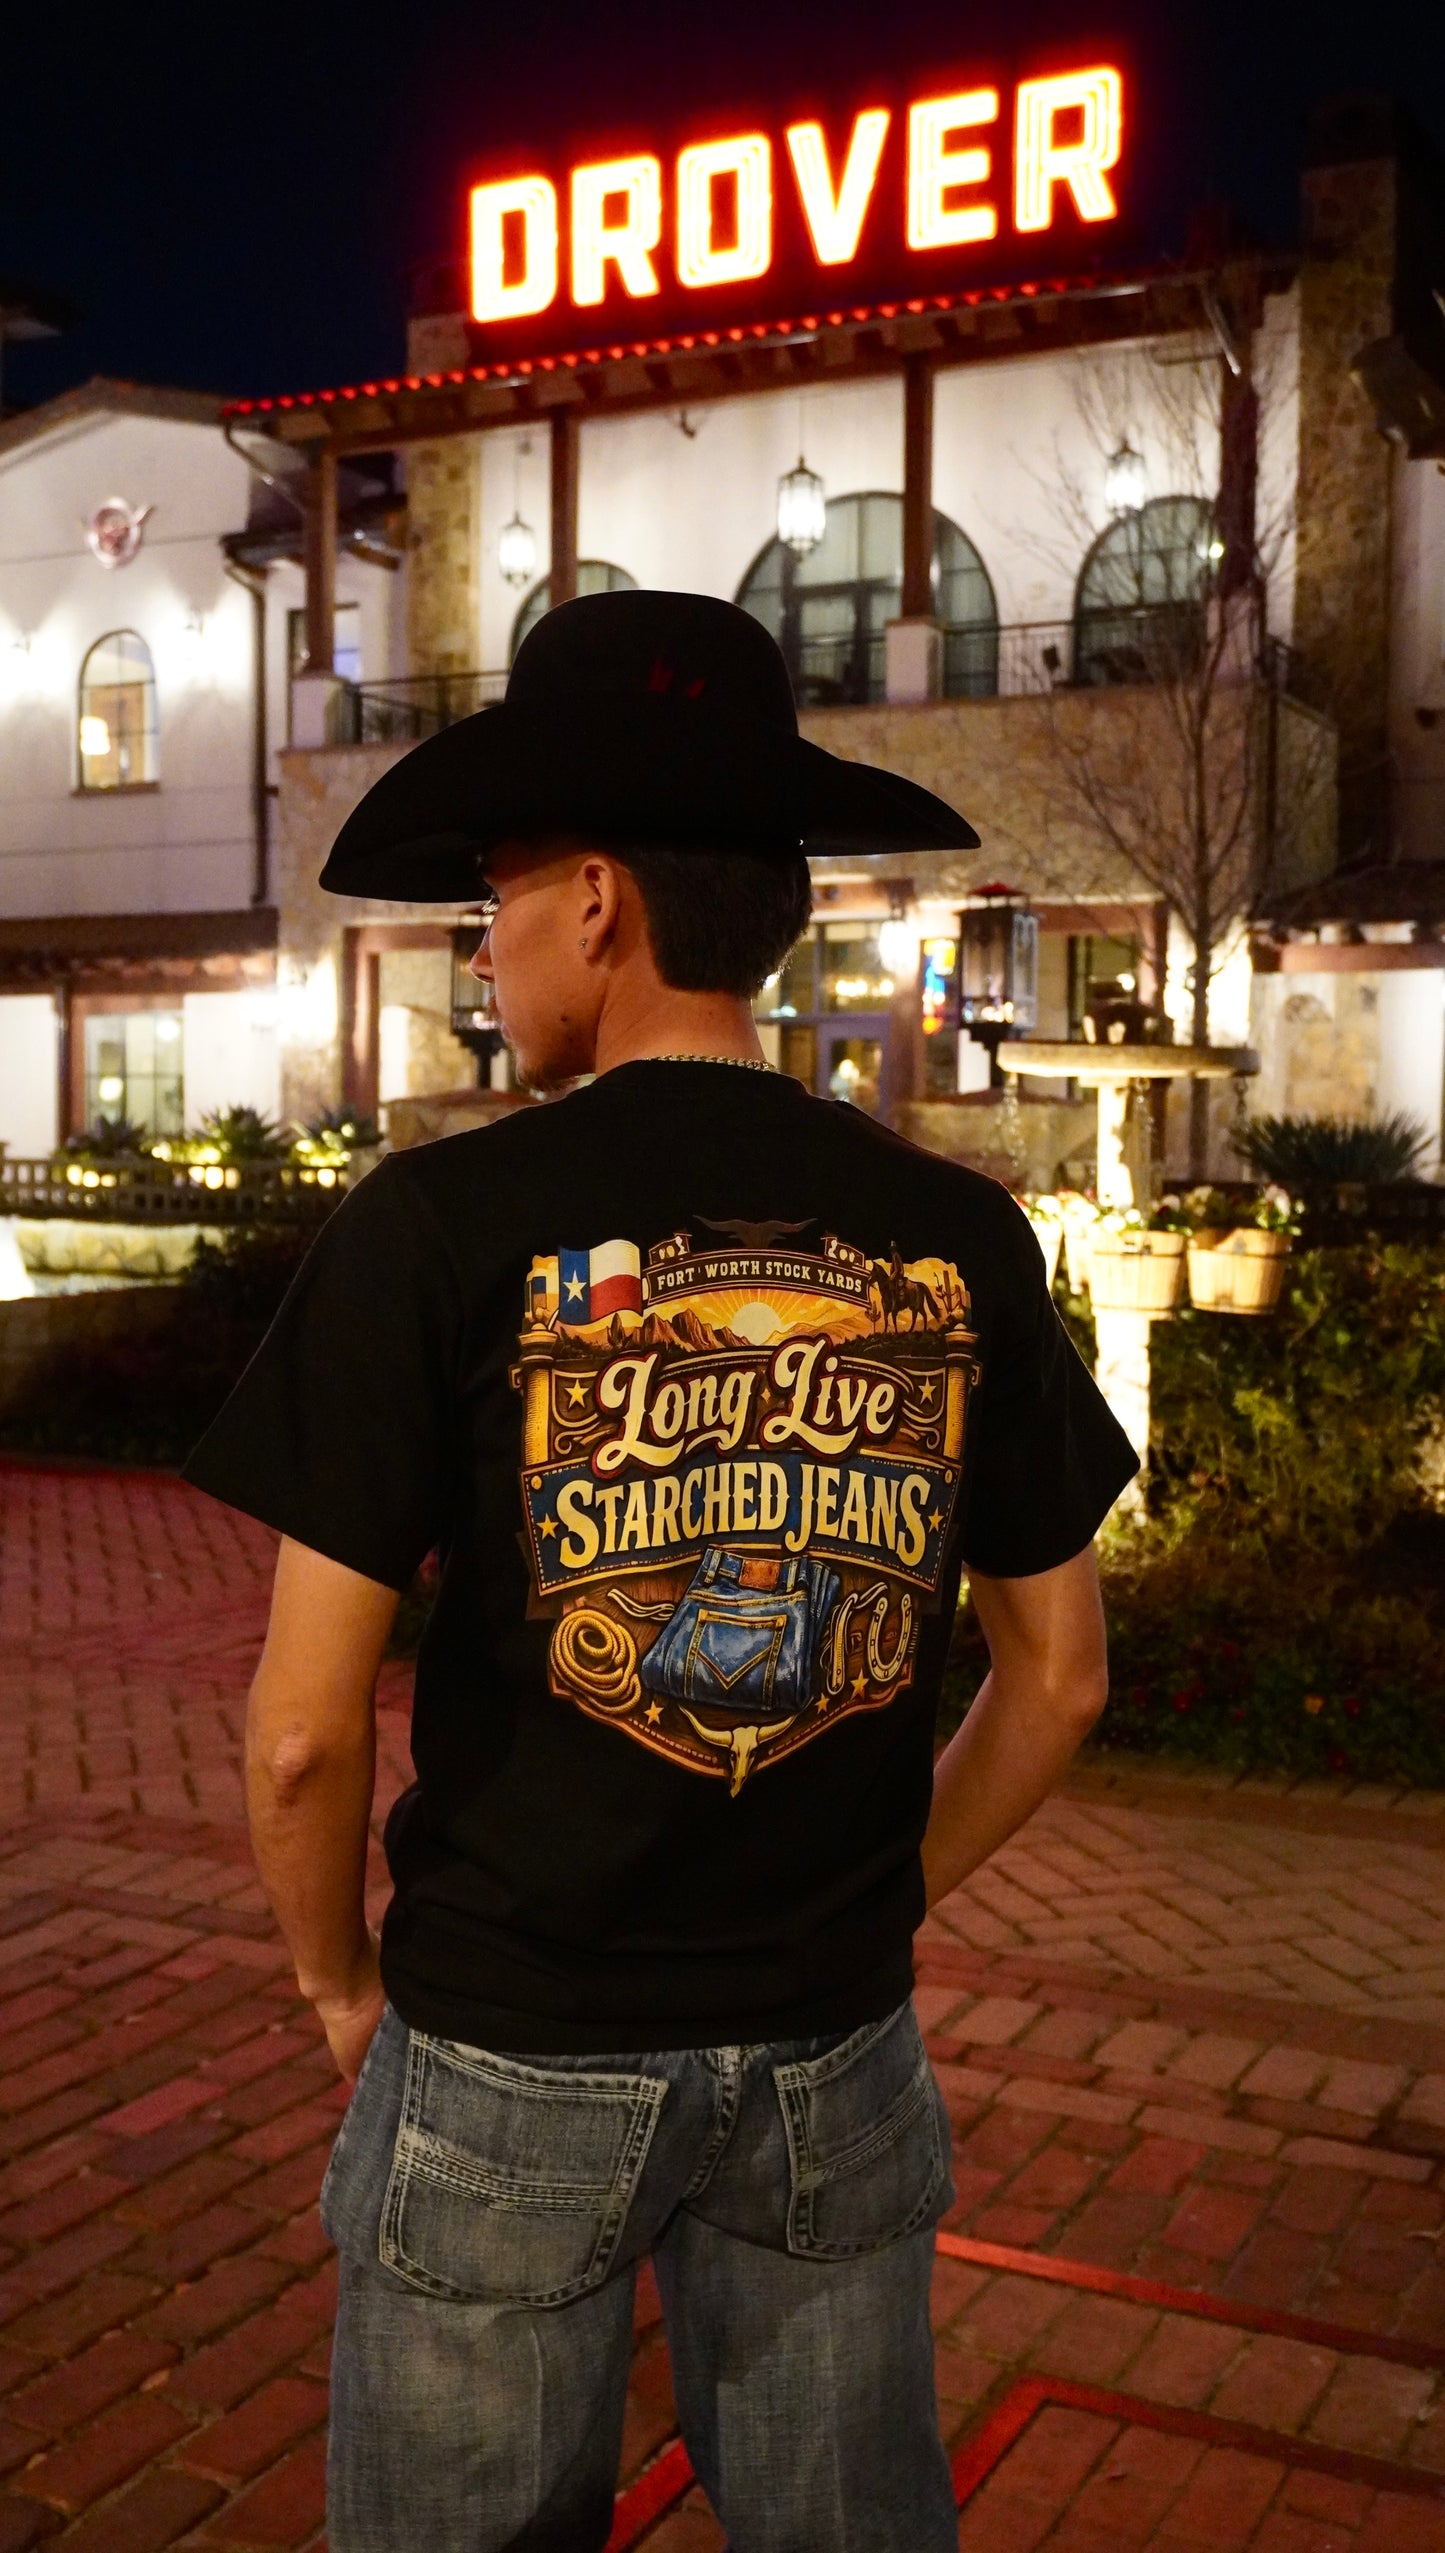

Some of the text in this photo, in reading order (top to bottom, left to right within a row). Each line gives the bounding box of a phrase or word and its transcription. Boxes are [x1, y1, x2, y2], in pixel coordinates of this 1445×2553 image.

[470, 65, 1122, 323] DROVER
[657, 1260, 863, 1293] FORT WORTH STOCK YARDS
[597, 1340, 896, 1471] Long Live
[556, 1462, 932, 1569] STARCHED JEANS
